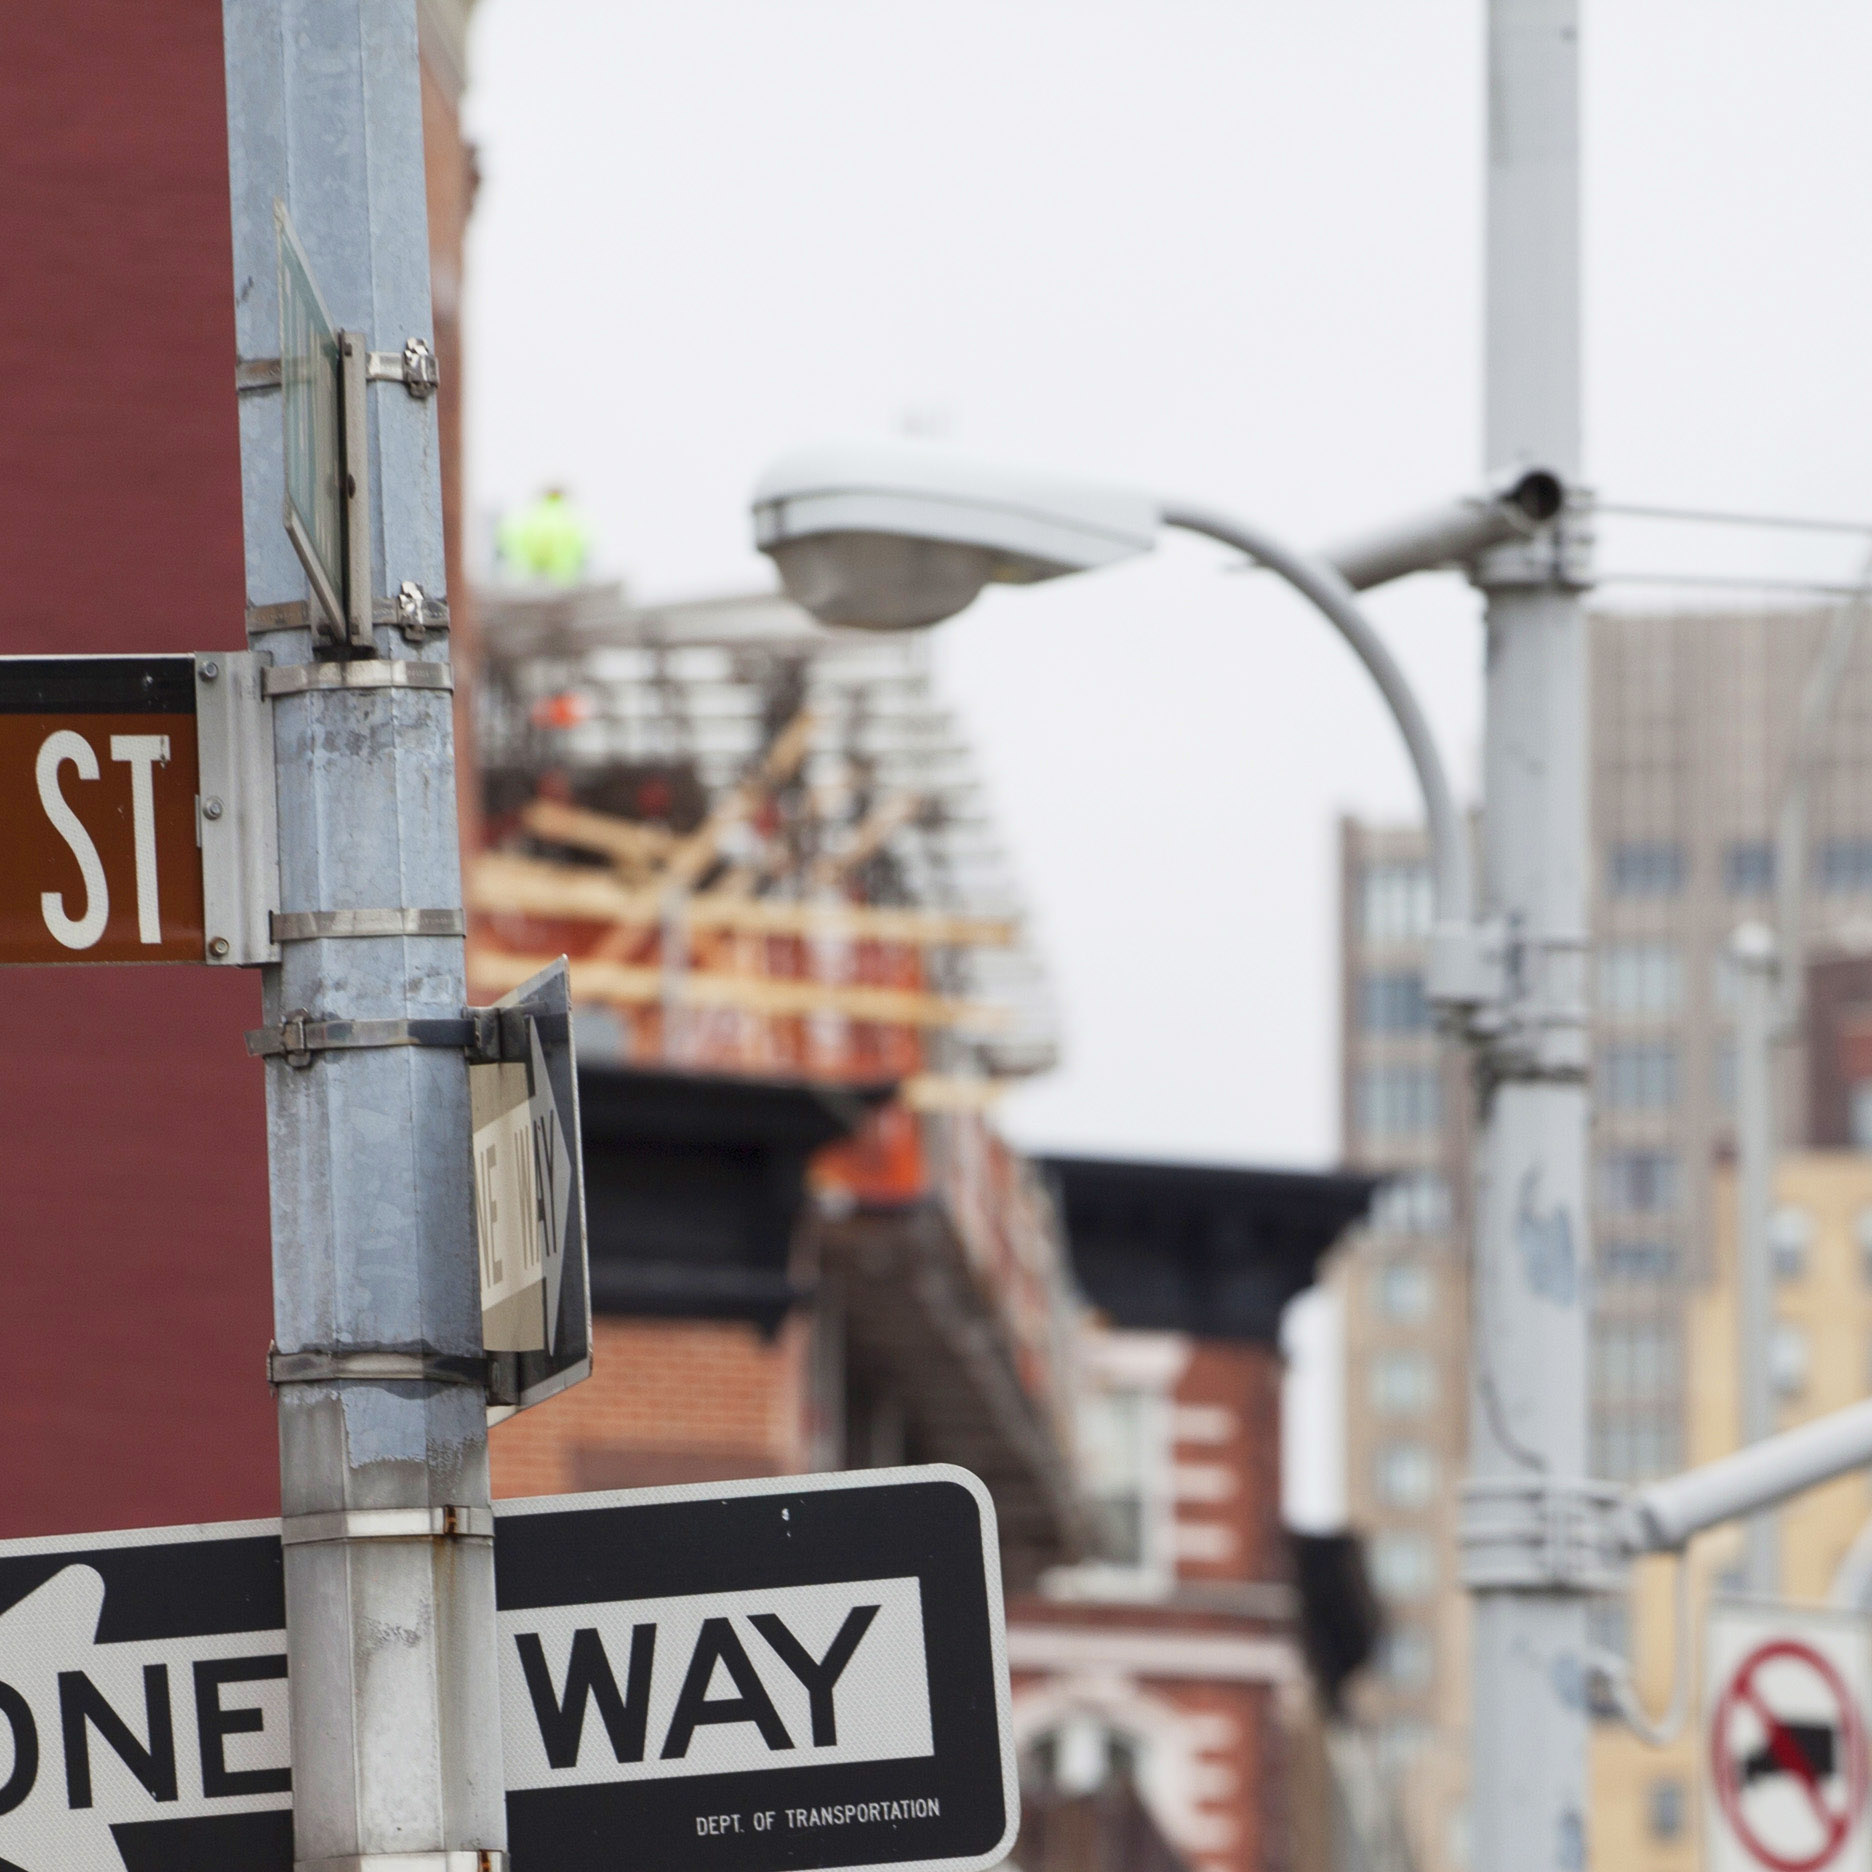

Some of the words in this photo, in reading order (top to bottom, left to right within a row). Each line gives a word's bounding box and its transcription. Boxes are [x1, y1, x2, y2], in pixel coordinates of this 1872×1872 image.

[35, 729, 172, 950] ST
[514, 1109, 558, 1272] WAY
[513, 1603, 883, 1771] WAY
[695, 1813, 746, 1836] DEPT.
[752, 1810, 777, 1832] OF
[784, 1797, 941, 1829] TRANSPORTATION
